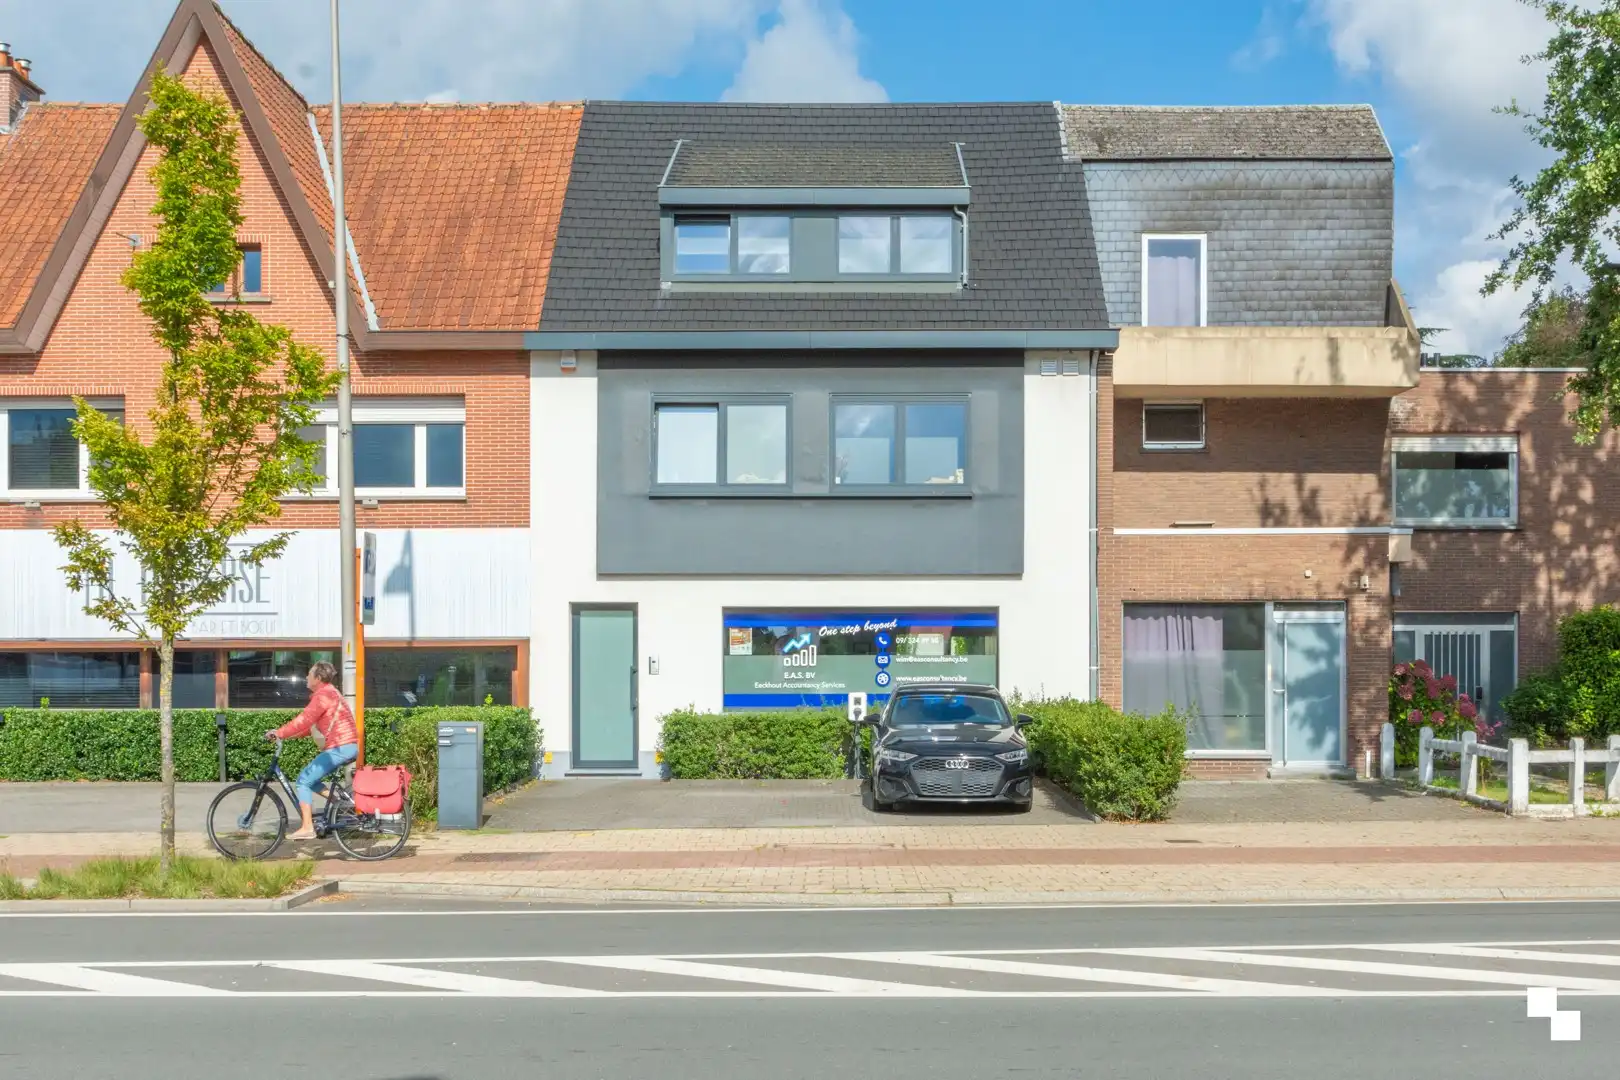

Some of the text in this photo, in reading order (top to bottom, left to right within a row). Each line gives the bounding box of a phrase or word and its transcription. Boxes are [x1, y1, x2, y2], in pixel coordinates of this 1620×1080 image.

[819, 619, 897, 636] One step beyond
[896, 655, 968, 664] wim@easconsultancy.be
[782, 682, 820, 690] Accountancy
[821, 681, 846, 689] Services
